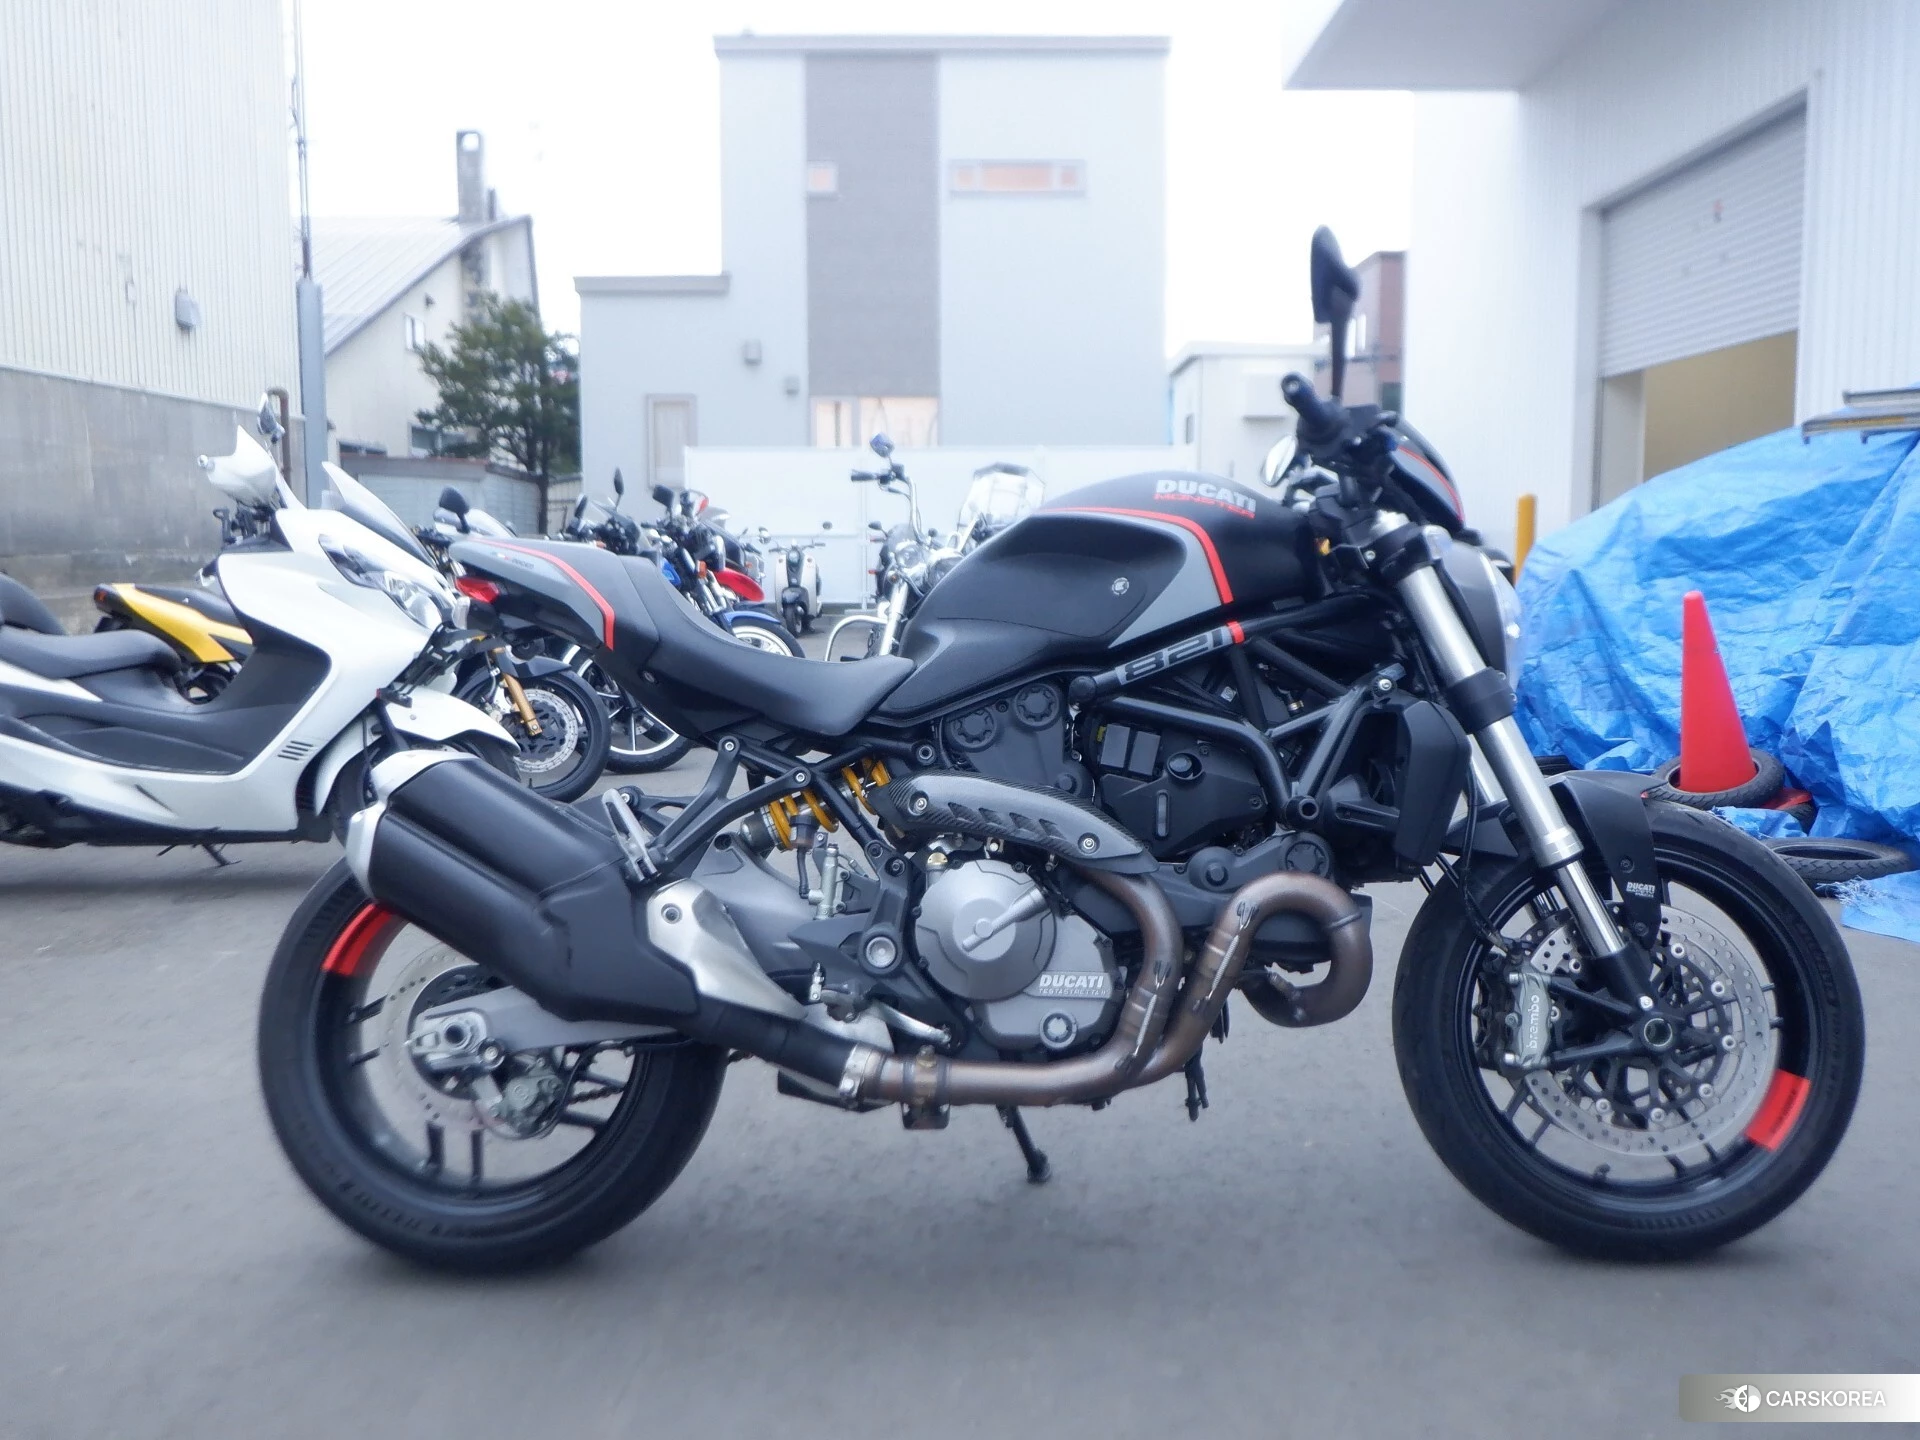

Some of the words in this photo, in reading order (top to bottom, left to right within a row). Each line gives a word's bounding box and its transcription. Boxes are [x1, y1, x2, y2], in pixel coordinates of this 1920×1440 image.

[1156, 480, 1256, 512] DUCATI
[1125, 628, 1223, 681] 821
[1627, 881, 1655, 891] DUCATI
[1040, 974, 1104, 988] DUCATI
[1526, 994, 1540, 1049] brembo
